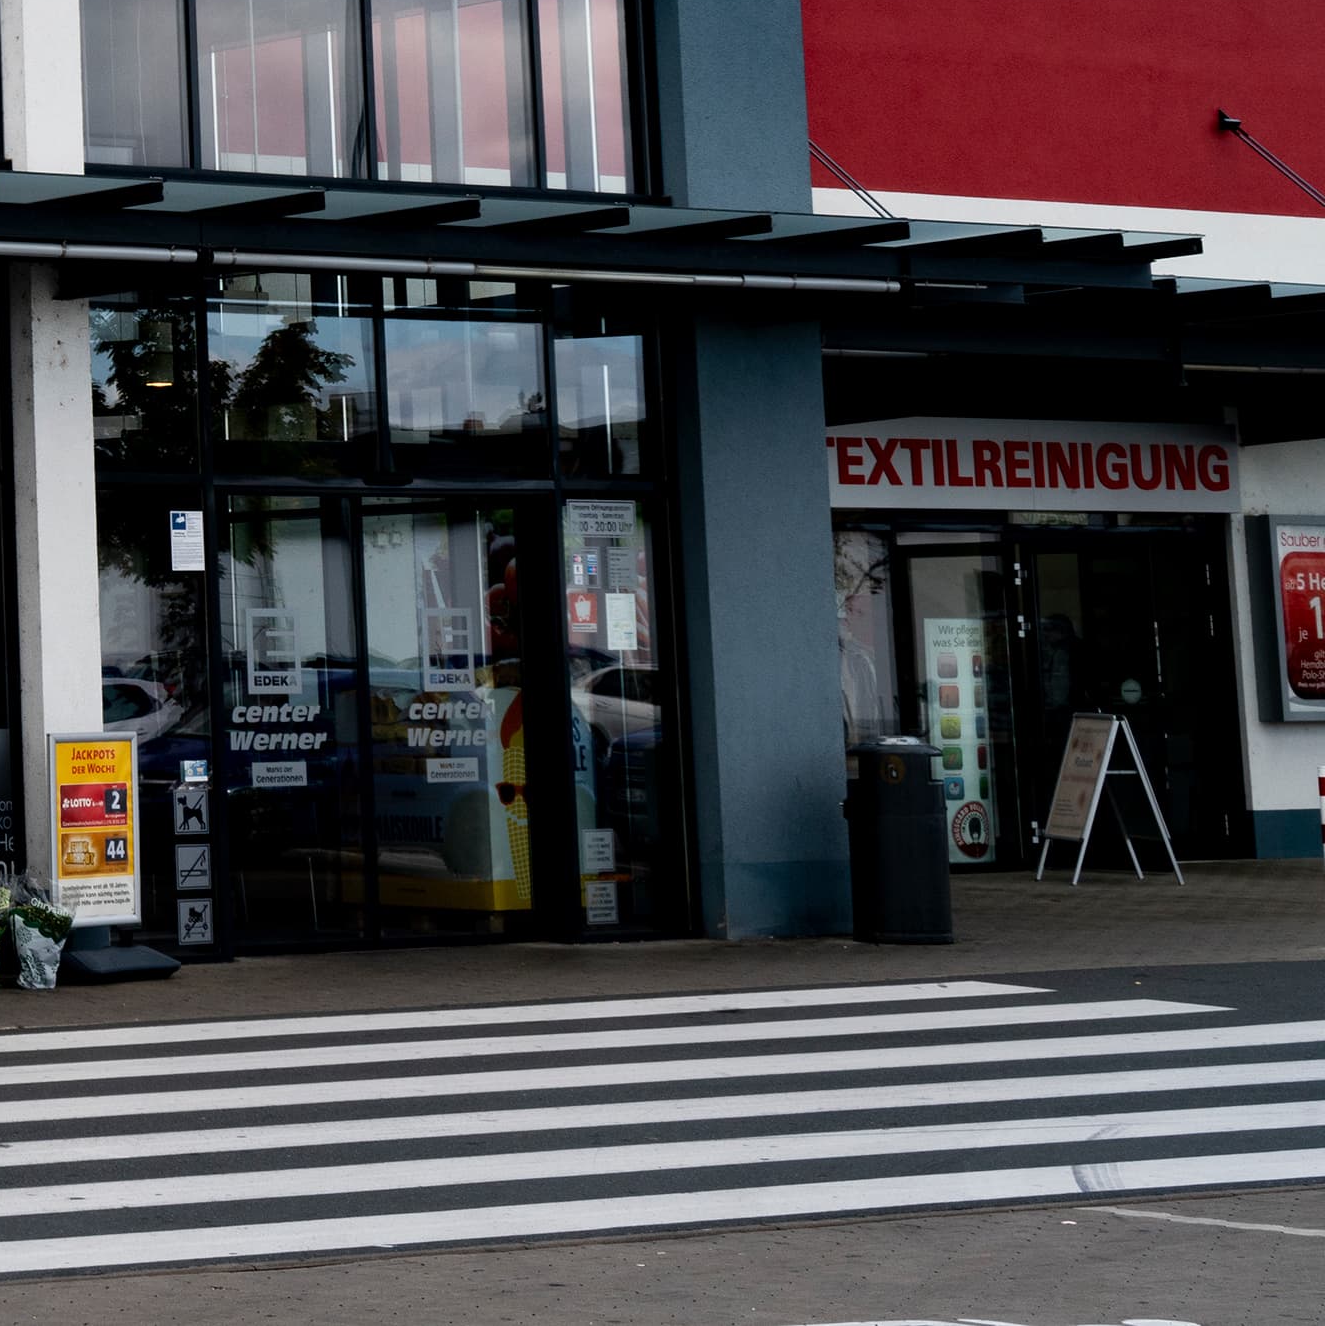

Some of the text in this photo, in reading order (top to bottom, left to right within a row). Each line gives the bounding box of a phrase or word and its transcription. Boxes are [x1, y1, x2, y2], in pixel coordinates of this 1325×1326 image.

[825, 436, 1230, 492] EXTILREINIGUNG
[1281, 532, 1321, 547] Sauber
[1296, 573, 1305, 590] 5
[1298, 626, 1309, 643] je
[253, 675, 298, 686] EDEKA
[429, 673, 471, 684] EDEKA
[231, 703, 321, 724] center
[229, 730, 328, 752] Werner
[407, 727, 487, 747] Werne
[71, 747, 116, 761] JACKPOTS
[87, 763, 116, 774] WOCHE
[70, 798, 92, 808] LOTTO
[111, 790, 121, 810] 2
[106, 839, 126, 859] 44
